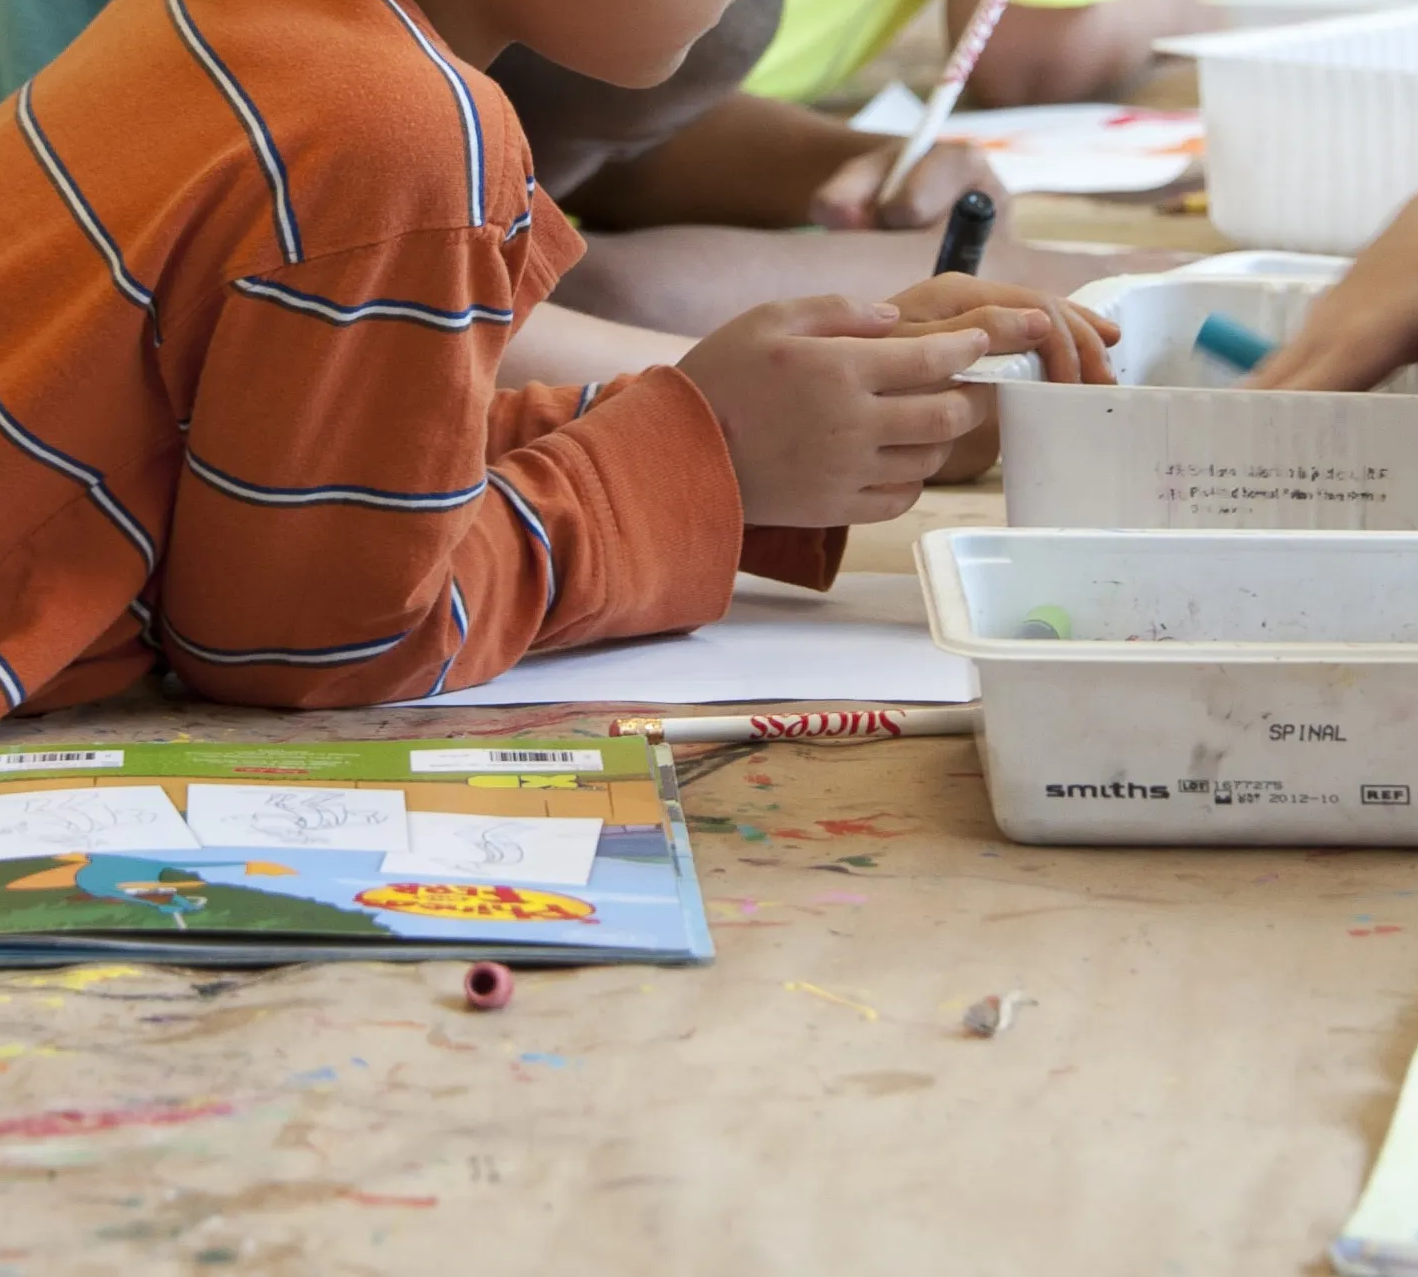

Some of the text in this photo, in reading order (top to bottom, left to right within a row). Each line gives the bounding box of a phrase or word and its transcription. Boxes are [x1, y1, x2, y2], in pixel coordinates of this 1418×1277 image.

[749, 708, 906, 739] Success
[1269, 724, 1347, 742] SPINAL
[1045, 782, 1171, 799] smiths
[1268, 793, 1340, 804] 2012-10
[1365, 789, 1406, 802] REF
